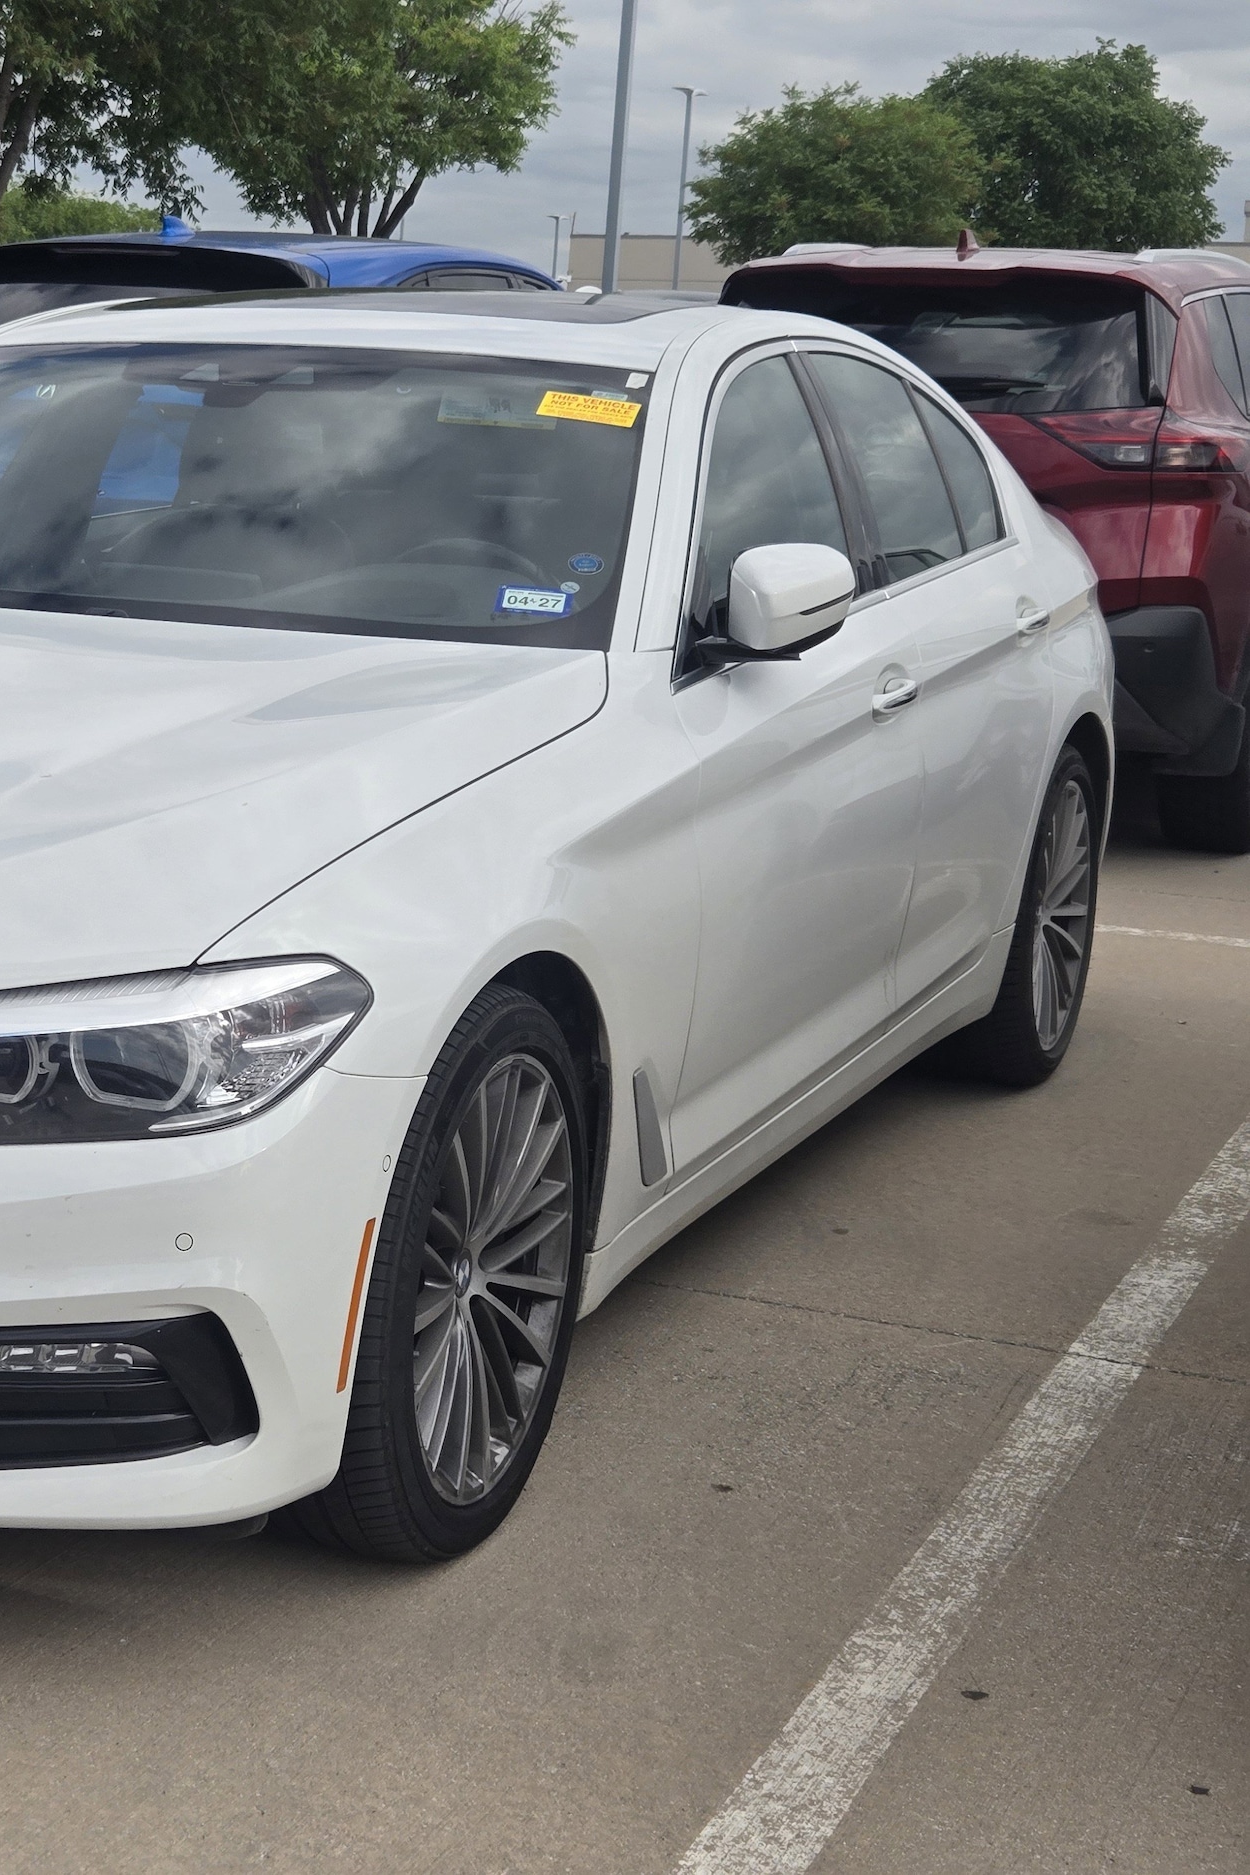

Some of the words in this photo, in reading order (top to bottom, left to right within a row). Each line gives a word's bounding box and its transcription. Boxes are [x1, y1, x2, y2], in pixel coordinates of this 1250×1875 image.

[551, 393, 579, 402] THIS
[583, 397, 637, 411] VEHICLE
[551, 399, 573, 407] NOT
[602, 406, 631, 415] SALE
